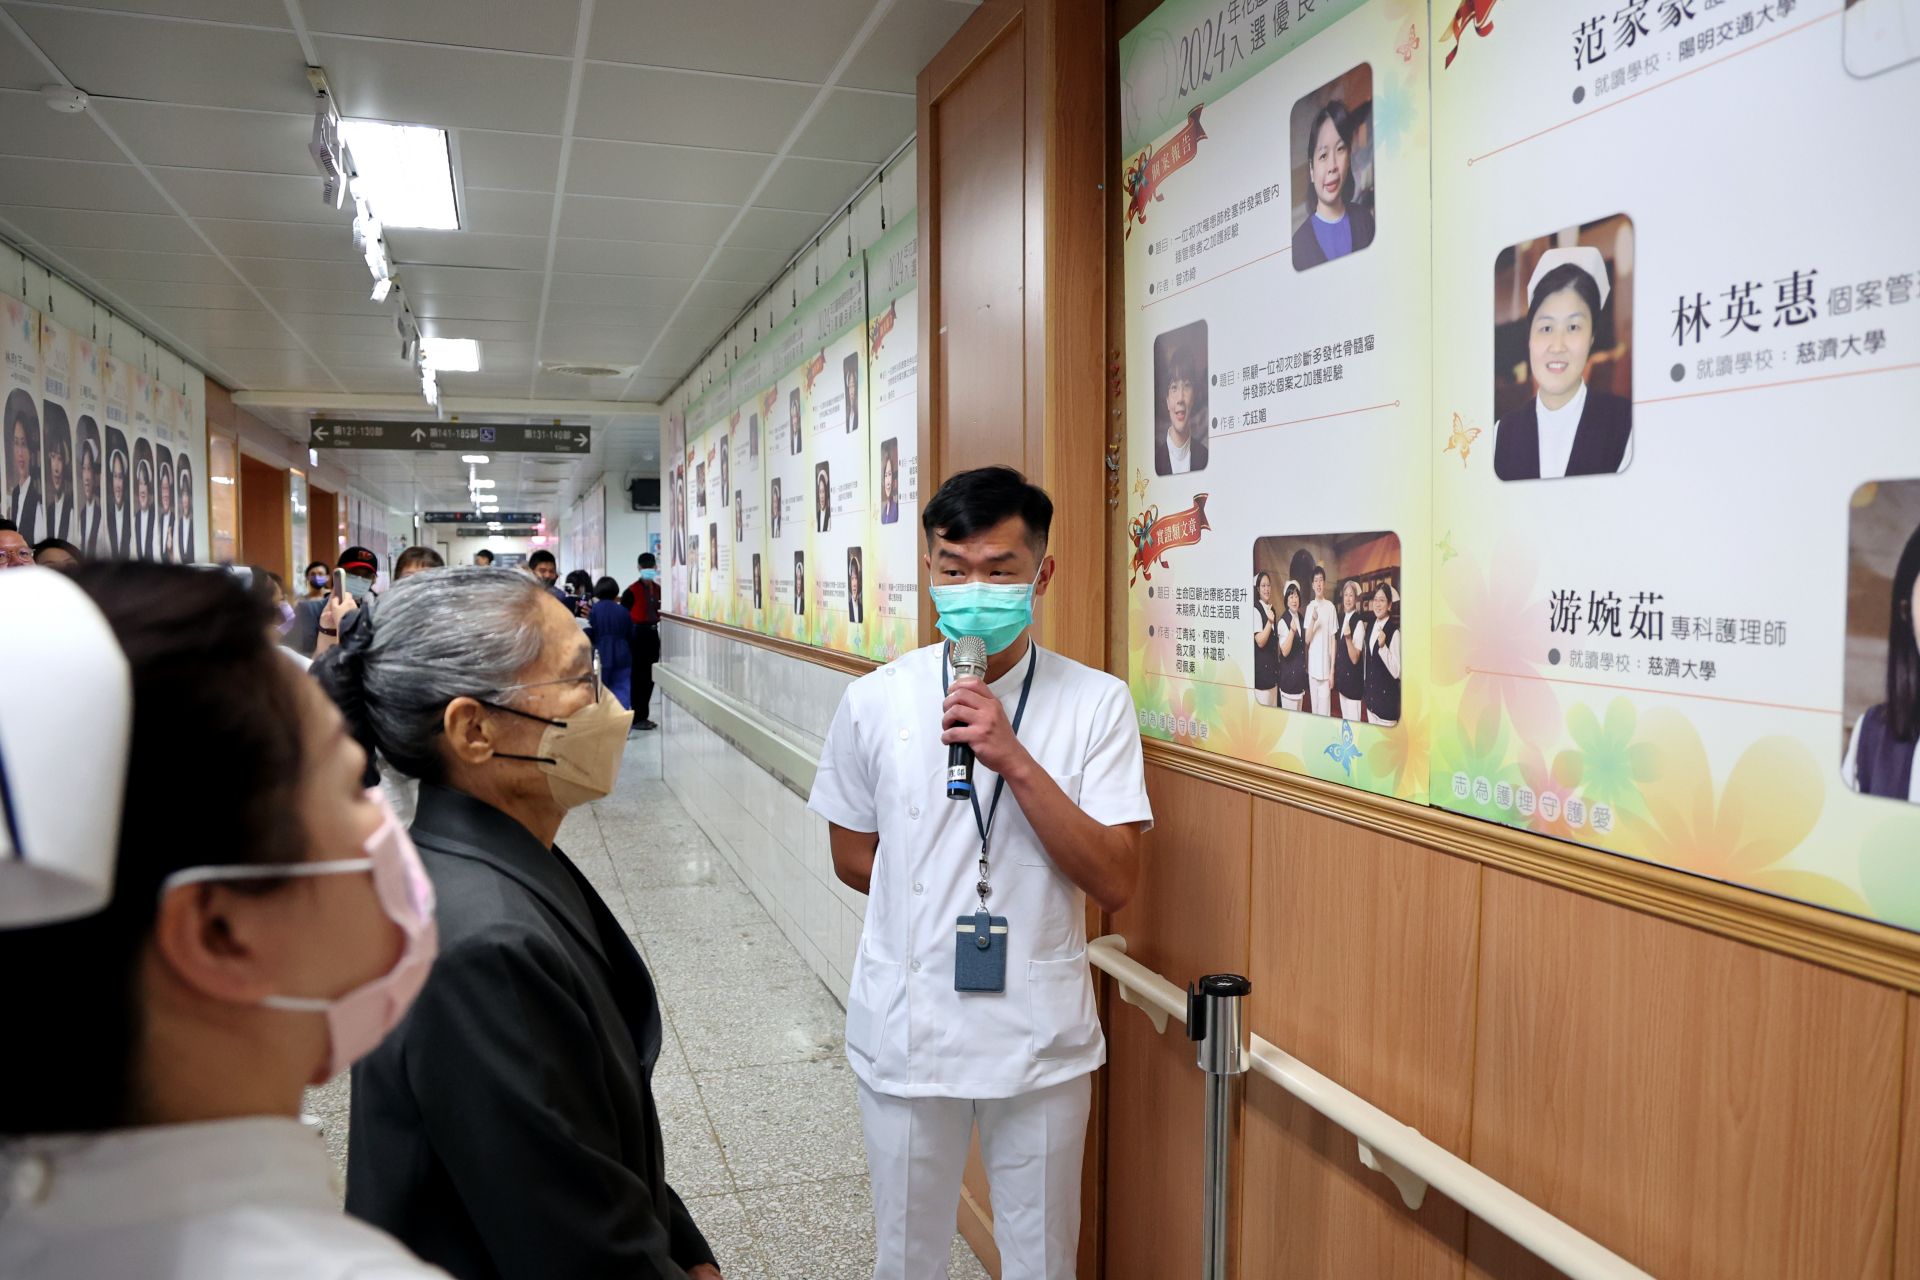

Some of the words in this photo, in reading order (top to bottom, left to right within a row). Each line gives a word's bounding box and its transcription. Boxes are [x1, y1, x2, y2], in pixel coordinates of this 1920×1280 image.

[1671, 268, 1818, 347] 林英惠
[1826, 269, 1920, 318] 個案管
[1696, 328, 1887, 380] 就讀學校：慈濟大學
[1550, 589, 1664, 641] 游婉茹
[1671, 615, 1788, 648] 專科護理師
[1569, 649, 1717, 682] 就讀學校：慈濟大學
[1453, 774, 1612, 834] 志為護理守護愛
